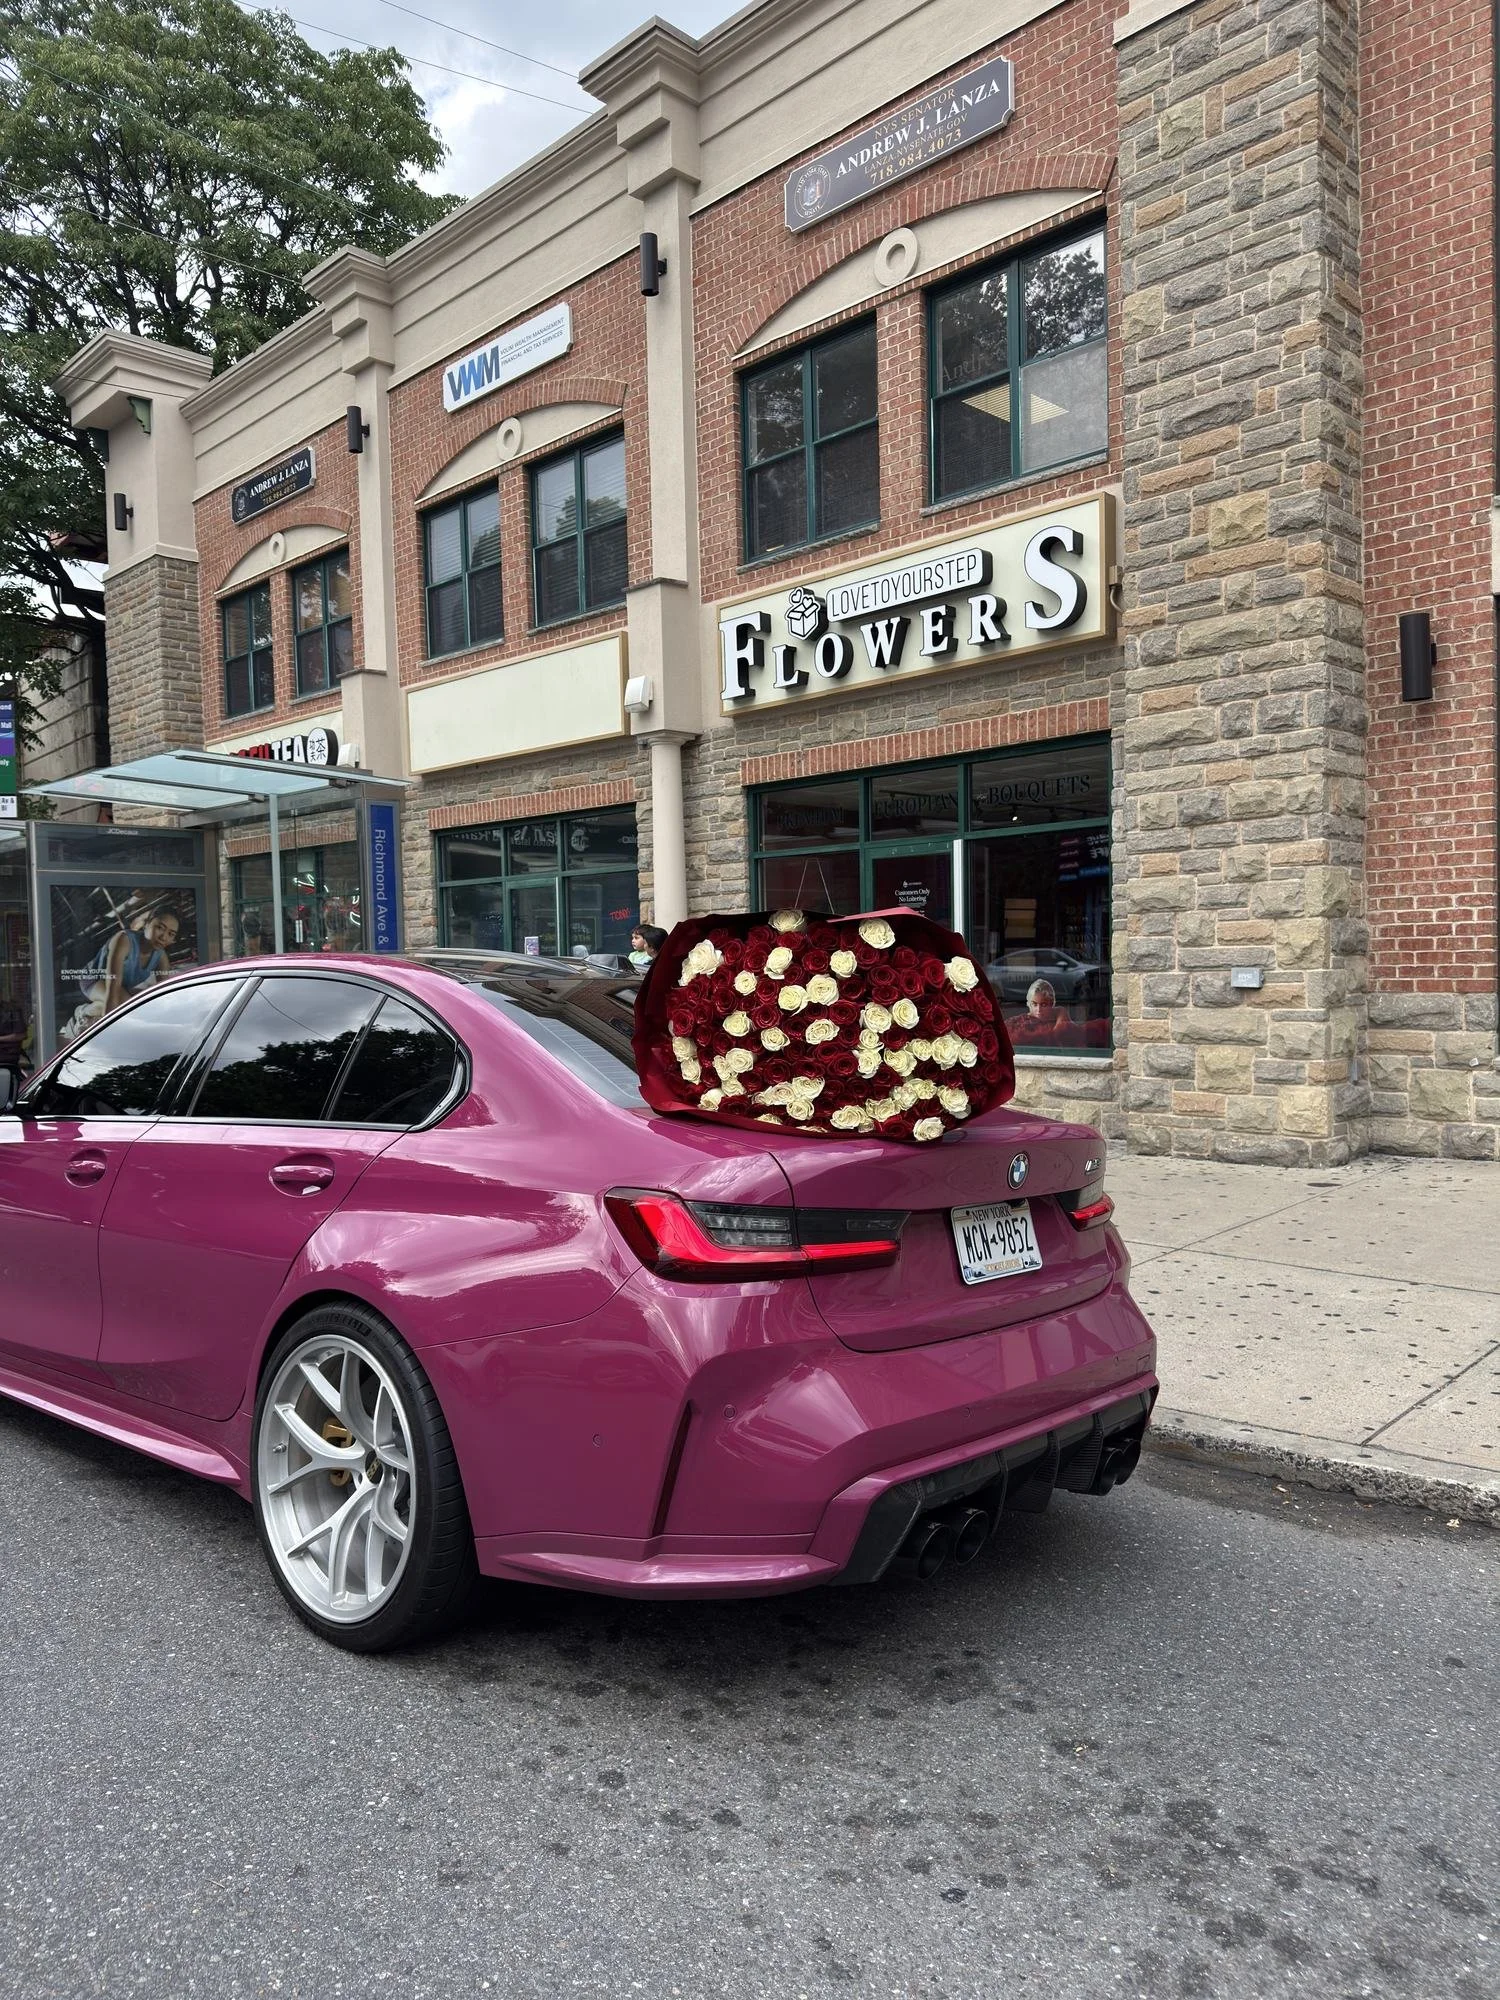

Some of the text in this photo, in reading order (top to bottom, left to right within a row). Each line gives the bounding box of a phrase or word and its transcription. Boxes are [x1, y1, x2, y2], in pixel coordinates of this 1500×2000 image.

[835, 79, 1000, 179] ANDREW J. LANZA
[874, 88, 956, 140] NYS SENATOR
[870, 128, 963, 185] 718.984.4073
[447, 345, 500, 402] VWM
[249, 475, 278, 498] ANDREW
[285, 459, 309, 478] LANZA
[830, 553, 978, 618] LOVETOYOURSTEP
[718, 525, 1087, 701] FLOWERS
[271, 735, 306, 763] TEA
[316, 738, 326, 759] 茶
[988, 774, 1092, 806] BOUQUETS
[374, 829, 390, 945] Richmond Ave &
[919, 888, 930, 896] Only
[972, 1205, 1012, 1222] NEW YORK
[996, 1216, 1034, 1256] 9852
